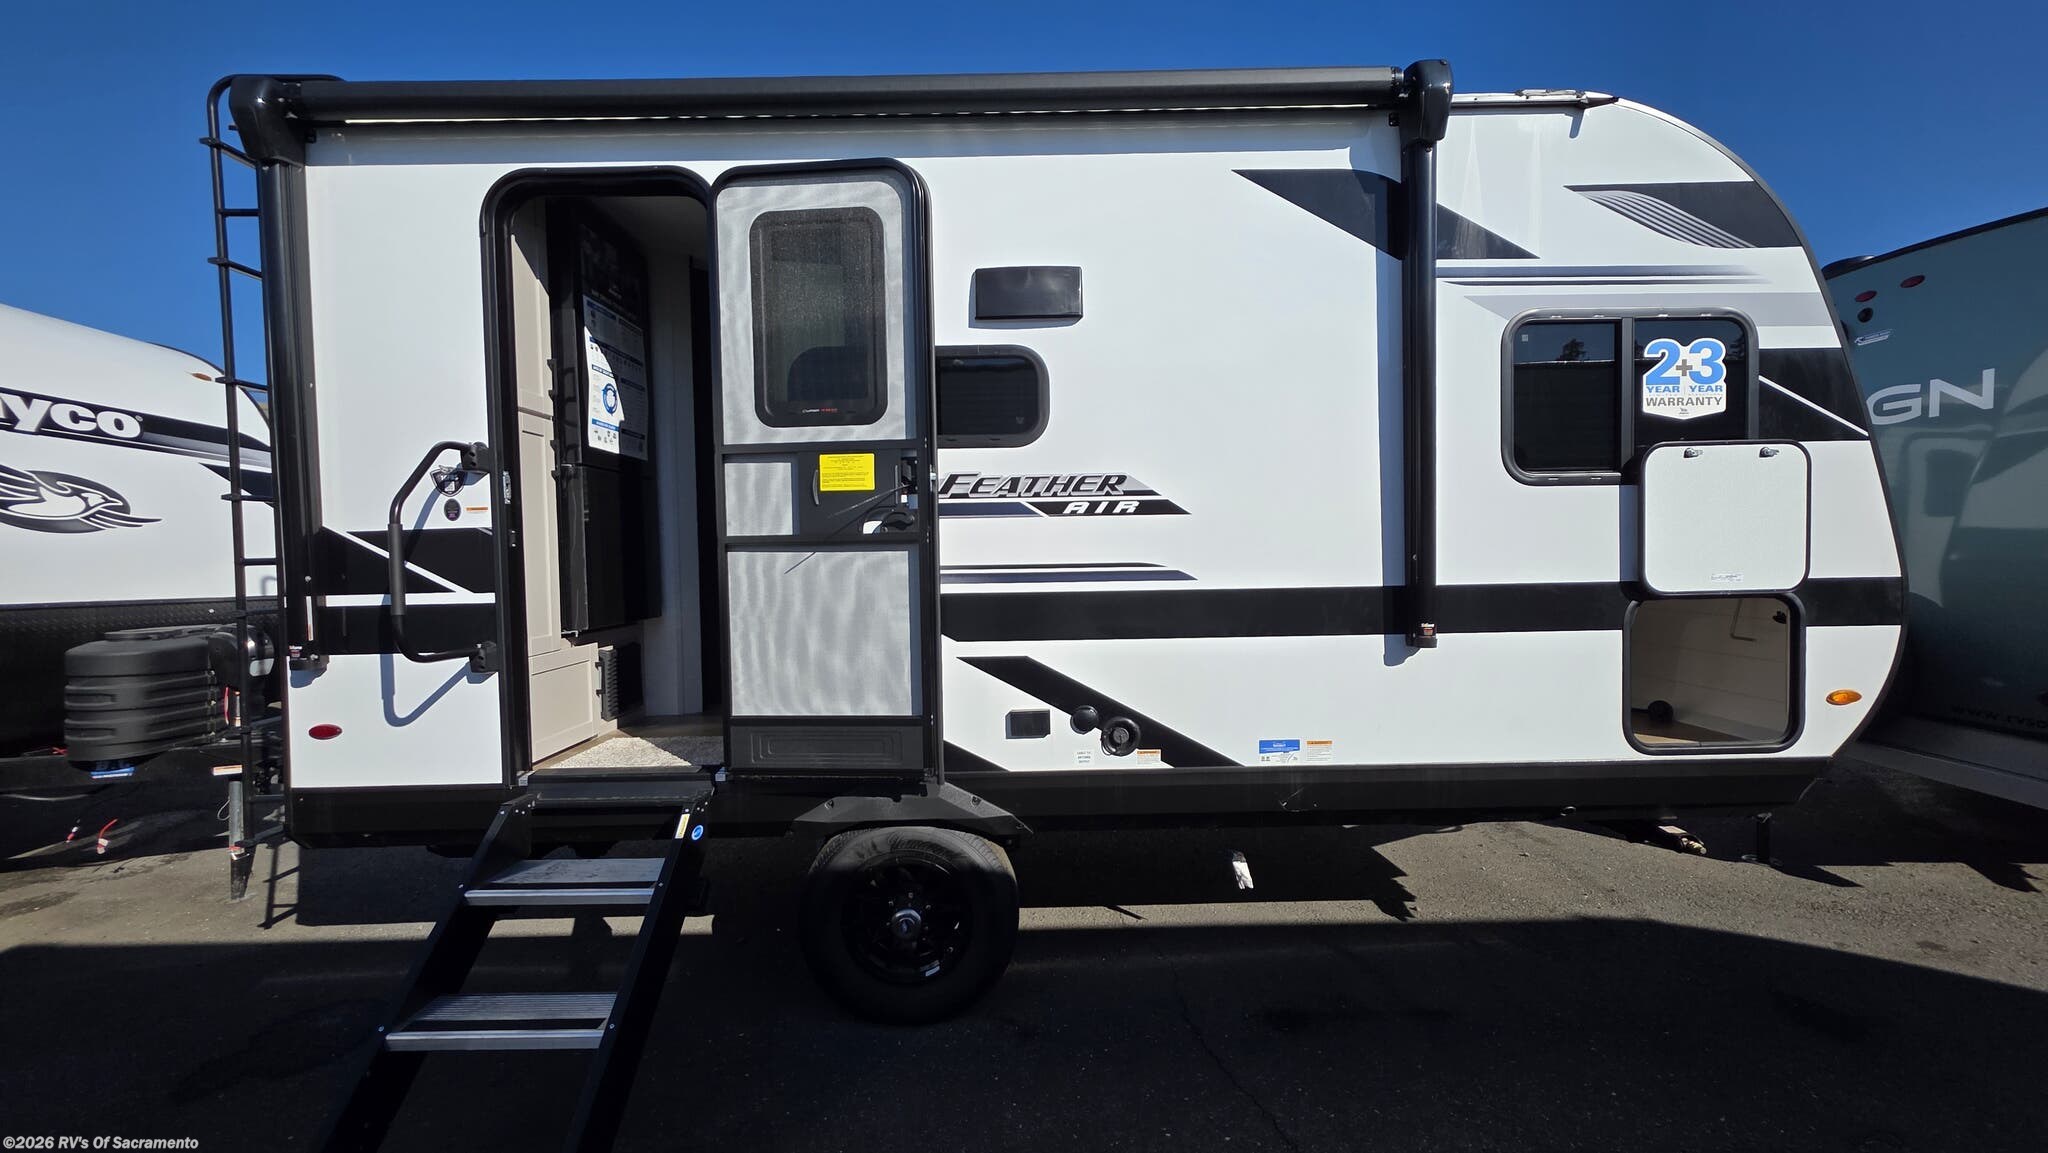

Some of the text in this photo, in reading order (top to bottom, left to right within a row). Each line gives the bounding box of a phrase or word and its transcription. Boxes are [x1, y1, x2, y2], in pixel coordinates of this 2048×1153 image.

[1646, 385, 1723, 393] YEAR YEAR
[1646, 397, 1722, 407] WARRANTY
[939, 472, 1127, 496] FEATHER
[1062, 501, 1140, 514] AIR
